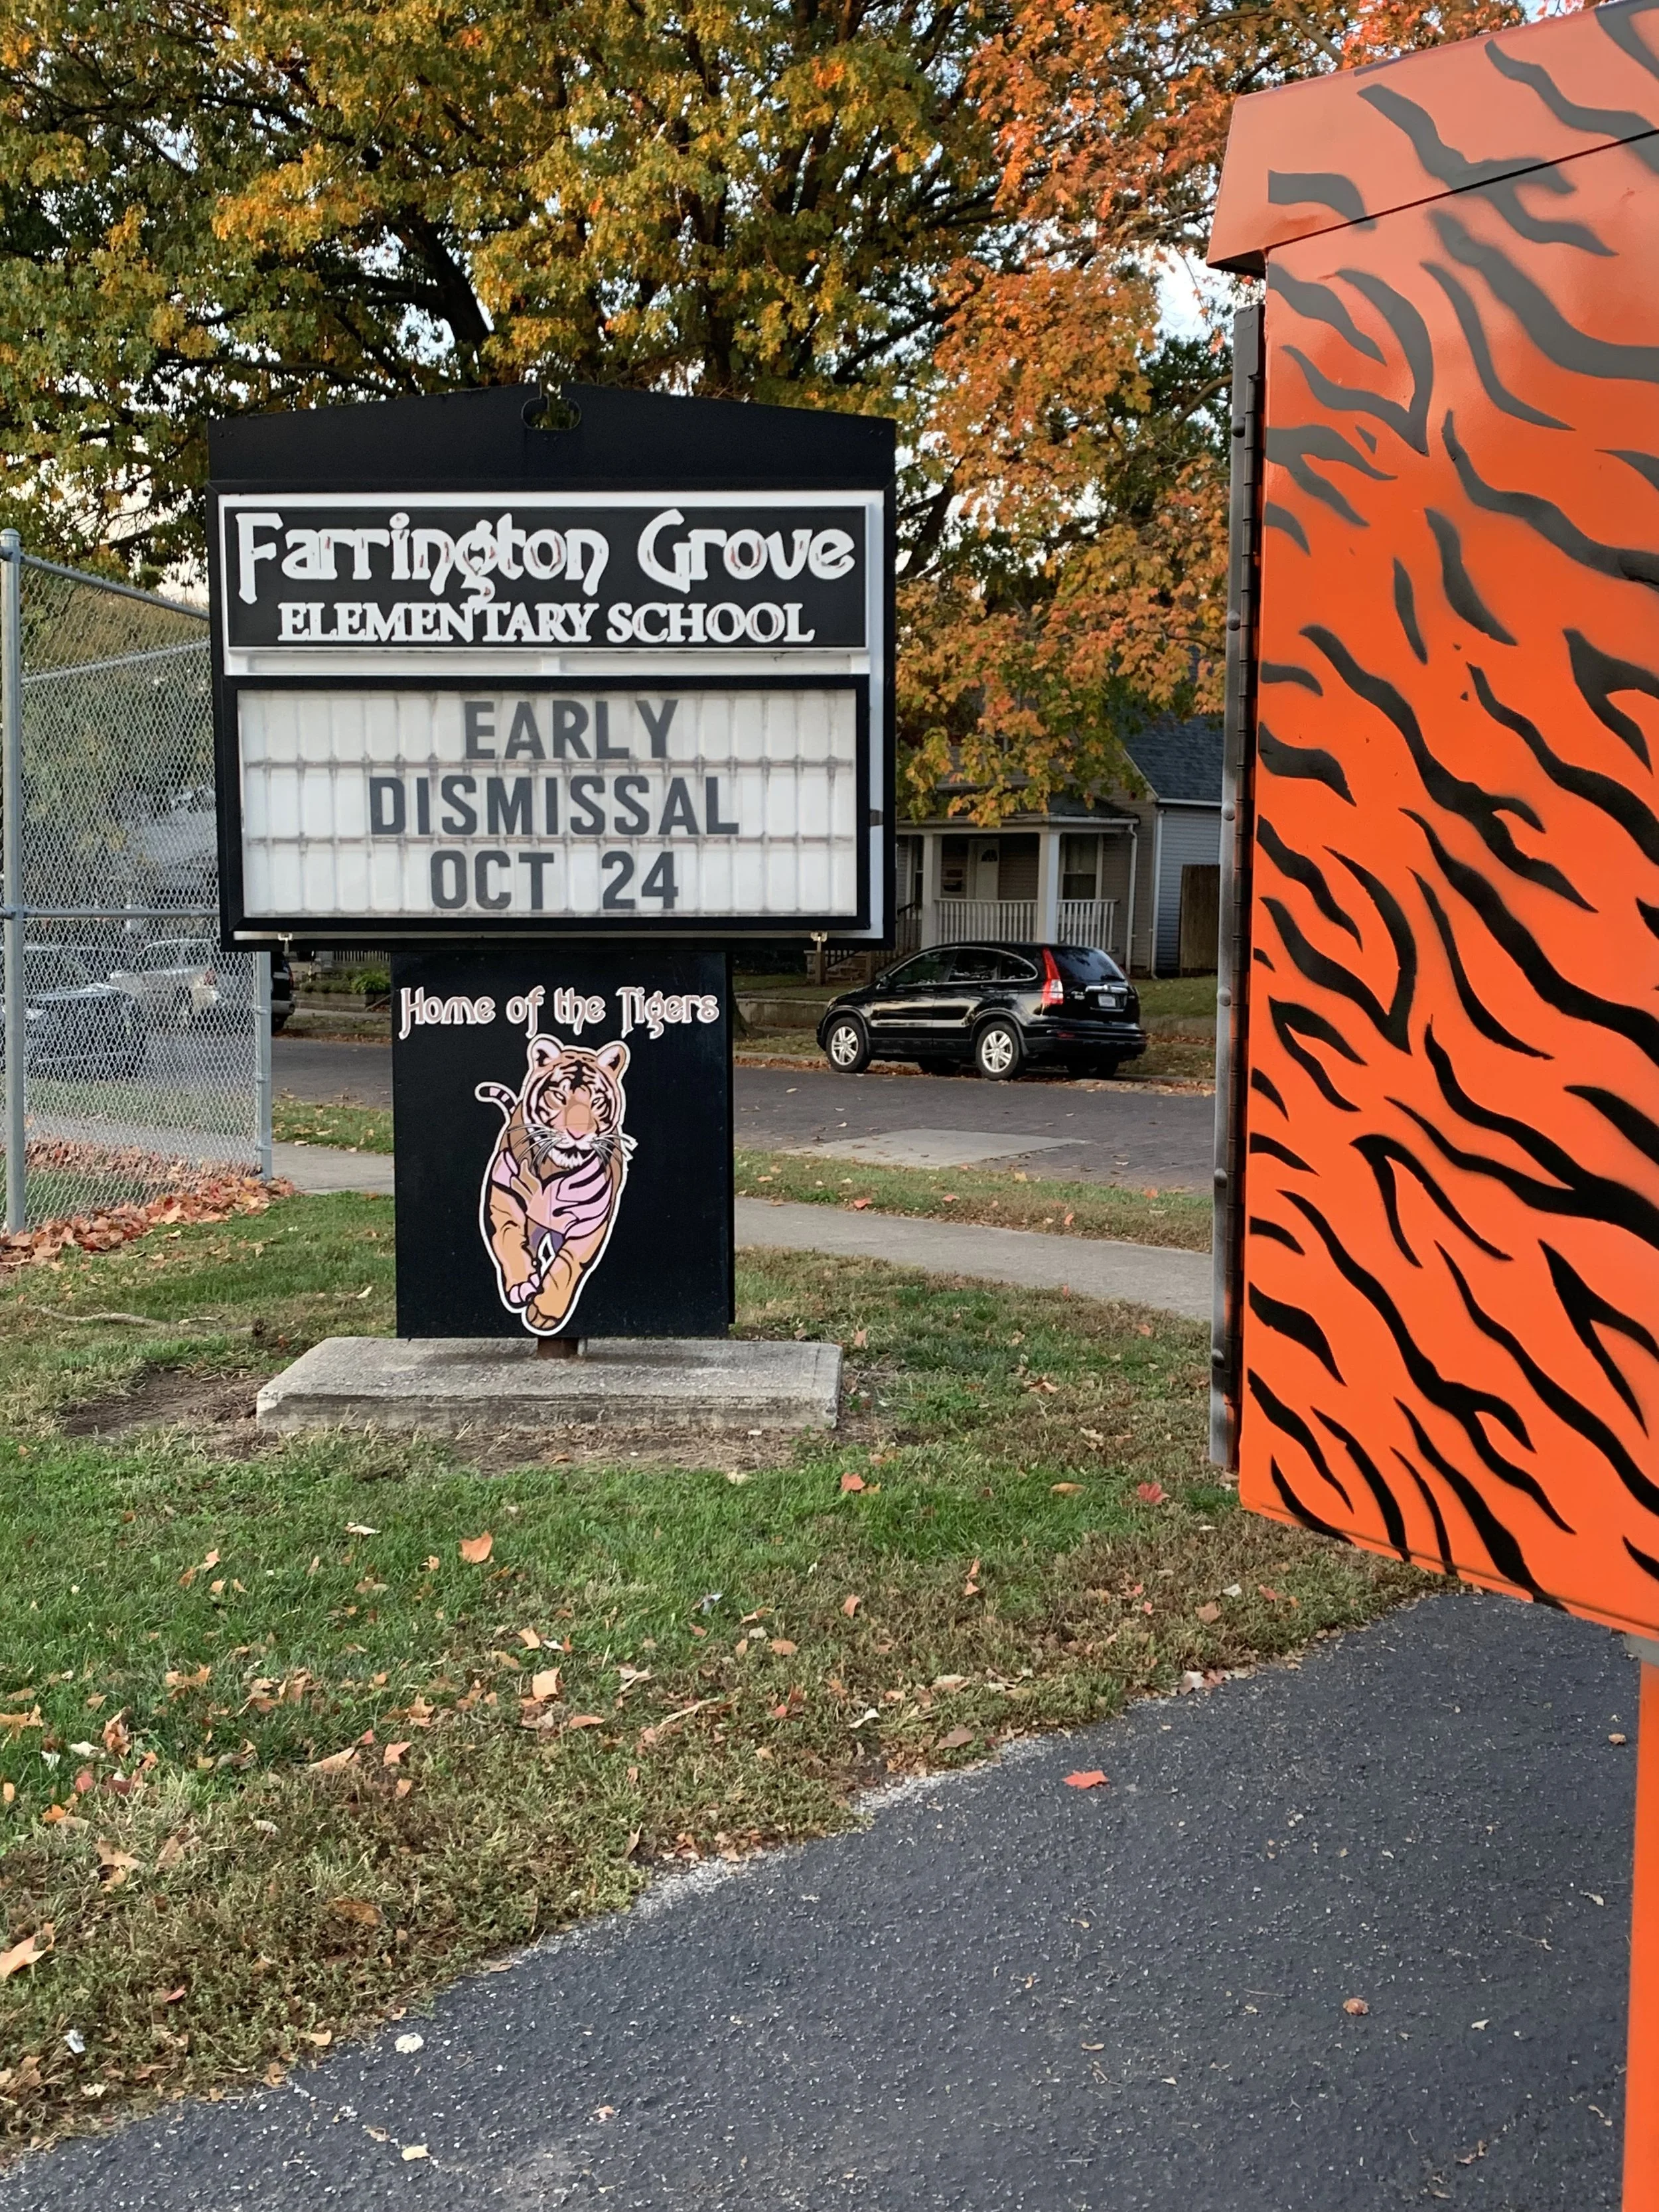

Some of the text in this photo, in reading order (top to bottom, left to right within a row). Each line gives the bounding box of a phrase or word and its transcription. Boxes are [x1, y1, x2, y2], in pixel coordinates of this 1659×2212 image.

[236, 509, 855, 605] Farrington Grove
[277, 602, 816, 643] ELEMENTARY SCHOOL
[464, 700, 678, 761] EARLY
[369, 774, 739, 836] DISMISSAL
[430, 850, 679, 911] OCT 24
[398, 985, 720, 1040] Home of the Tigers
